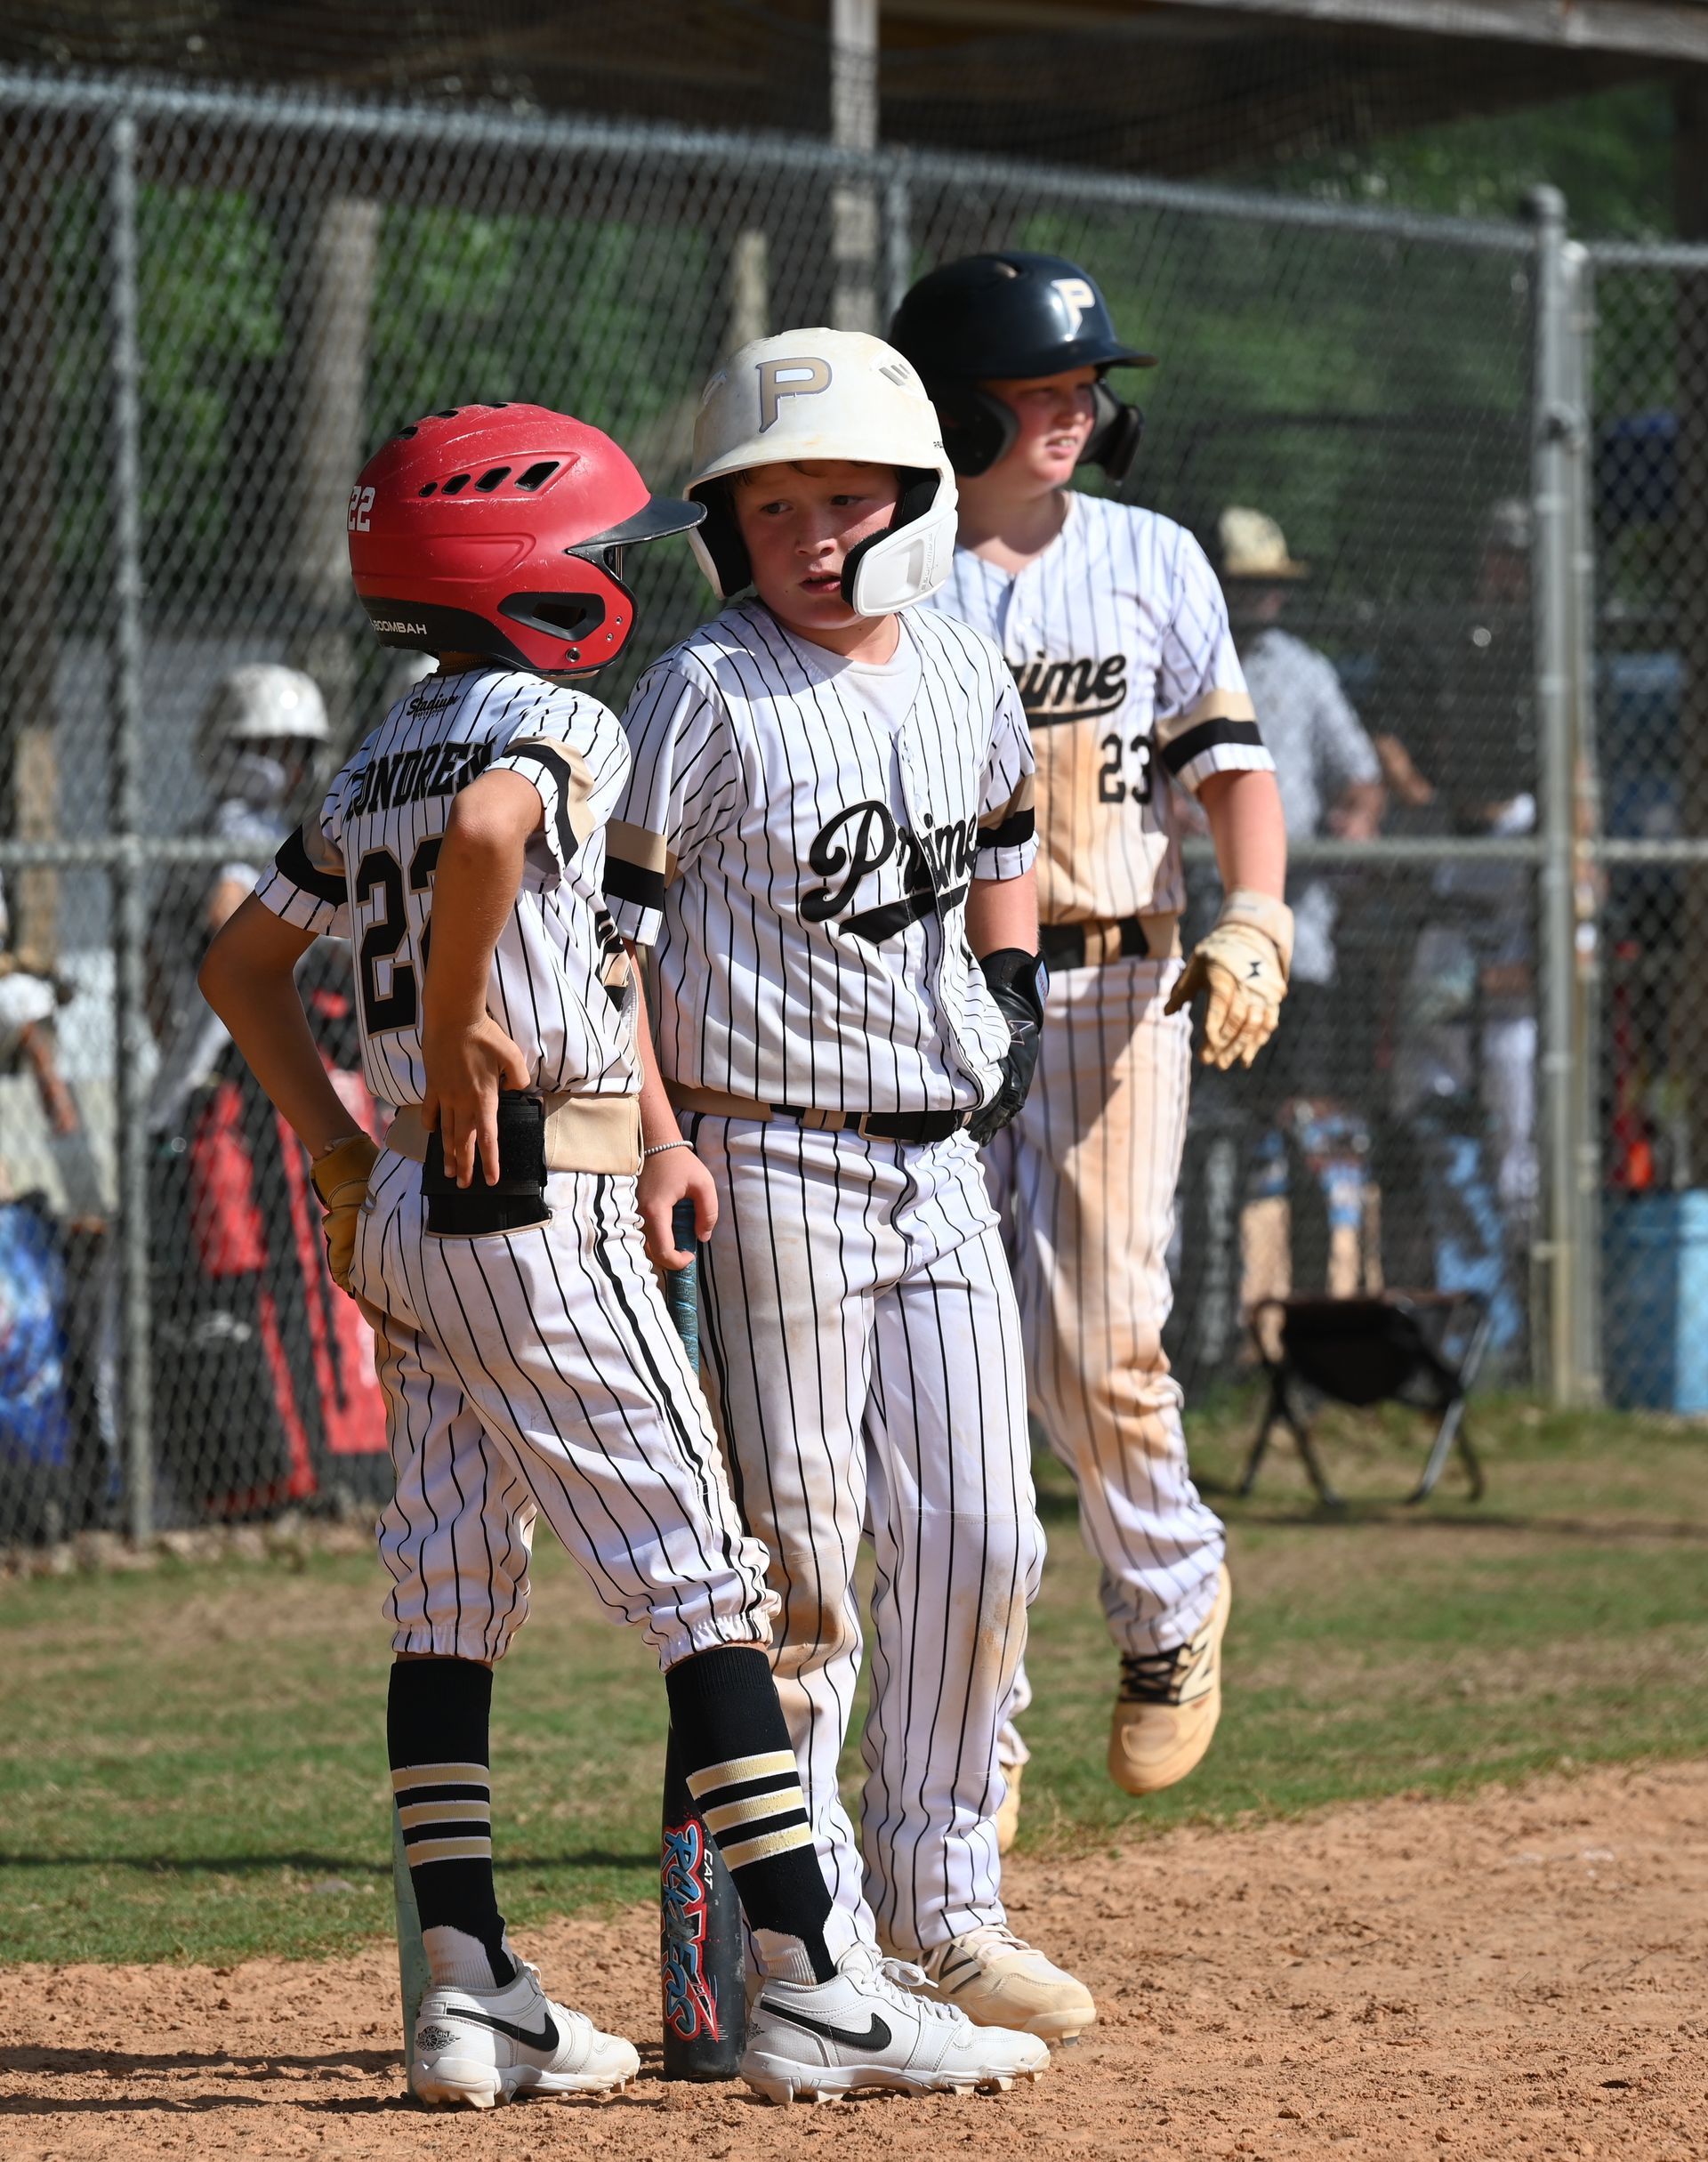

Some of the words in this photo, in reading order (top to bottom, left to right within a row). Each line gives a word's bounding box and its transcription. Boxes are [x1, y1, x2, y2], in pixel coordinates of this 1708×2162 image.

[1051, 278, 1096, 342] P
[756, 357, 833, 434] P
[348, 485, 376, 532] 22
[1099, 732, 1154, 804] 23
